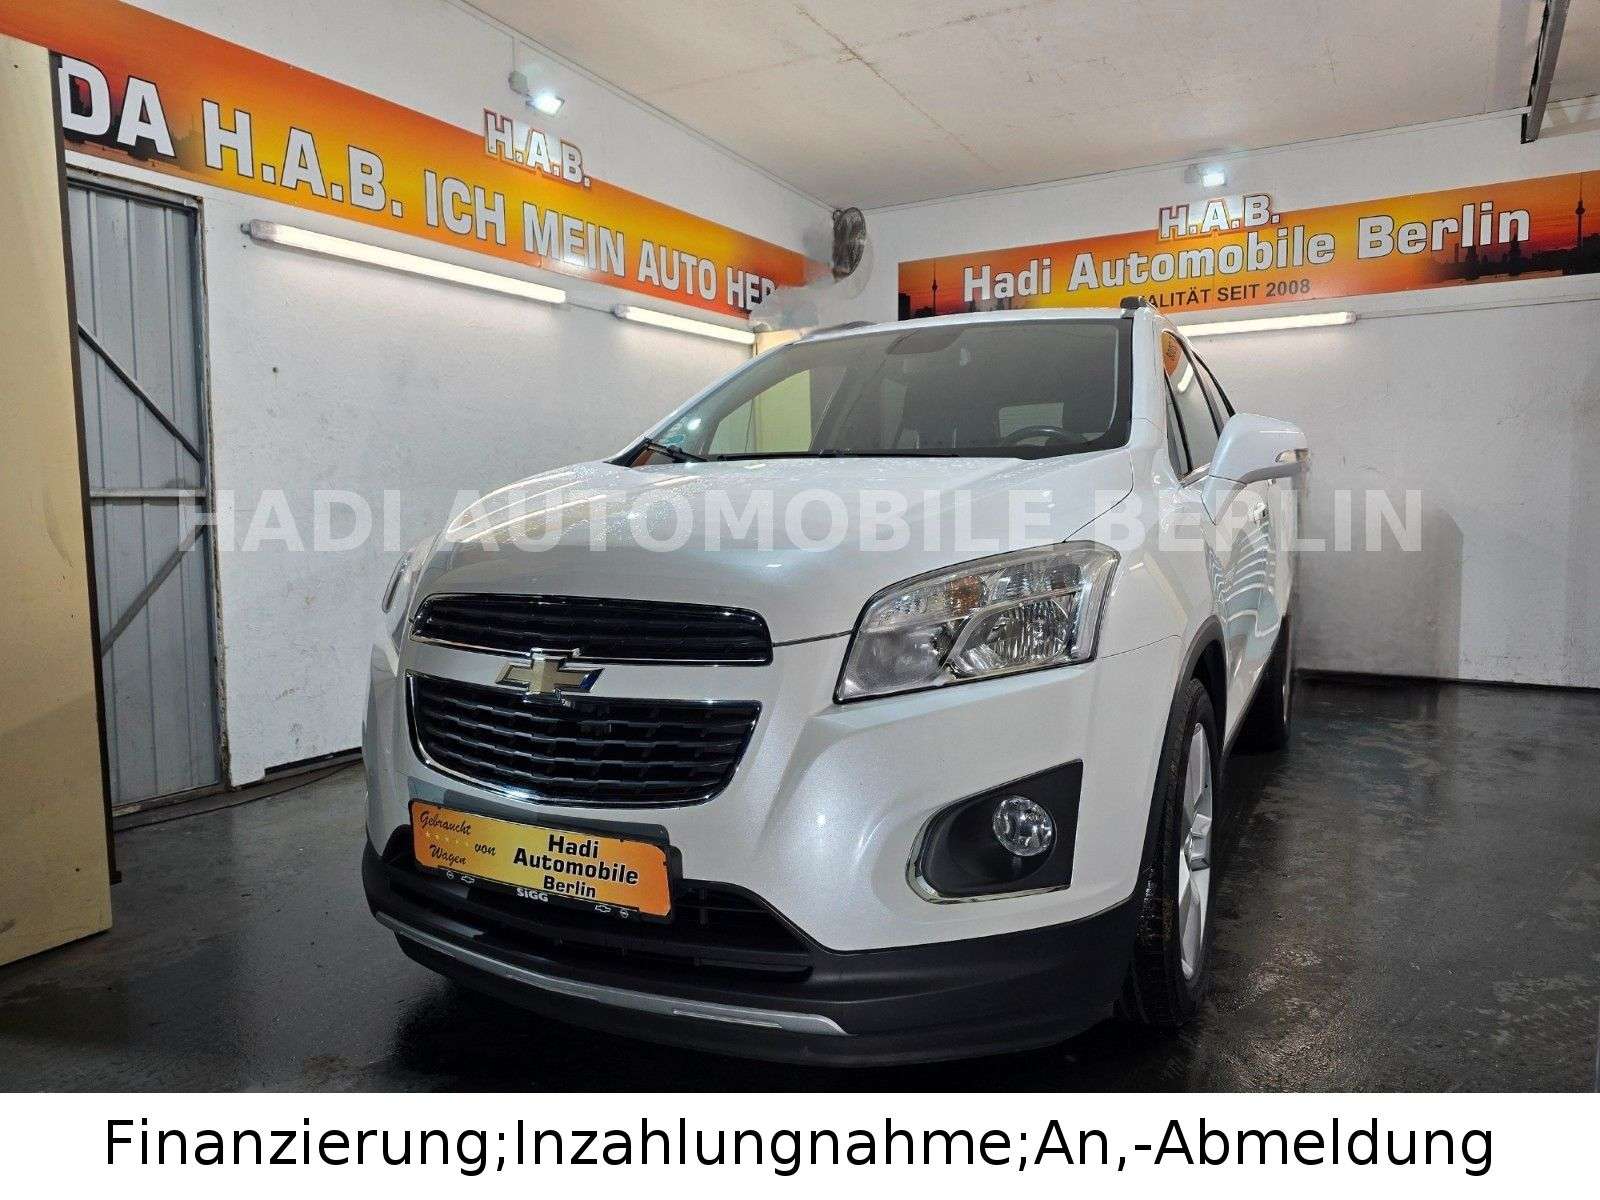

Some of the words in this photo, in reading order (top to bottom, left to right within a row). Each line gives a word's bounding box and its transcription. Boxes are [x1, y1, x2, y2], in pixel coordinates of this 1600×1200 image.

[483, 108, 592, 187] H.A.B.
[201, 98, 403, 218] H.A.B.
[424, 169, 506, 246] ICH
[522, 201, 625, 278] MEIN
[637, 240, 717, 301] AUTO
[1159, 194, 1280, 240] H.A.B.
[963, 259, 1051, 302] Hadi
[1067, 225, 1336, 292] Automobile
[1357, 201, 1531, 259] Berlin
[1217, 283, 1259, 302] SEIT
[1265, 278, 1312, 298] 2008
[420, 811, 472, 836] Gebraucht
[474, 842, 496, 857] von
[548, 834, 599, 859] Hadi
[513, 847, 639, 885] Automobile
[543, 875, 596, 899] Berlin
